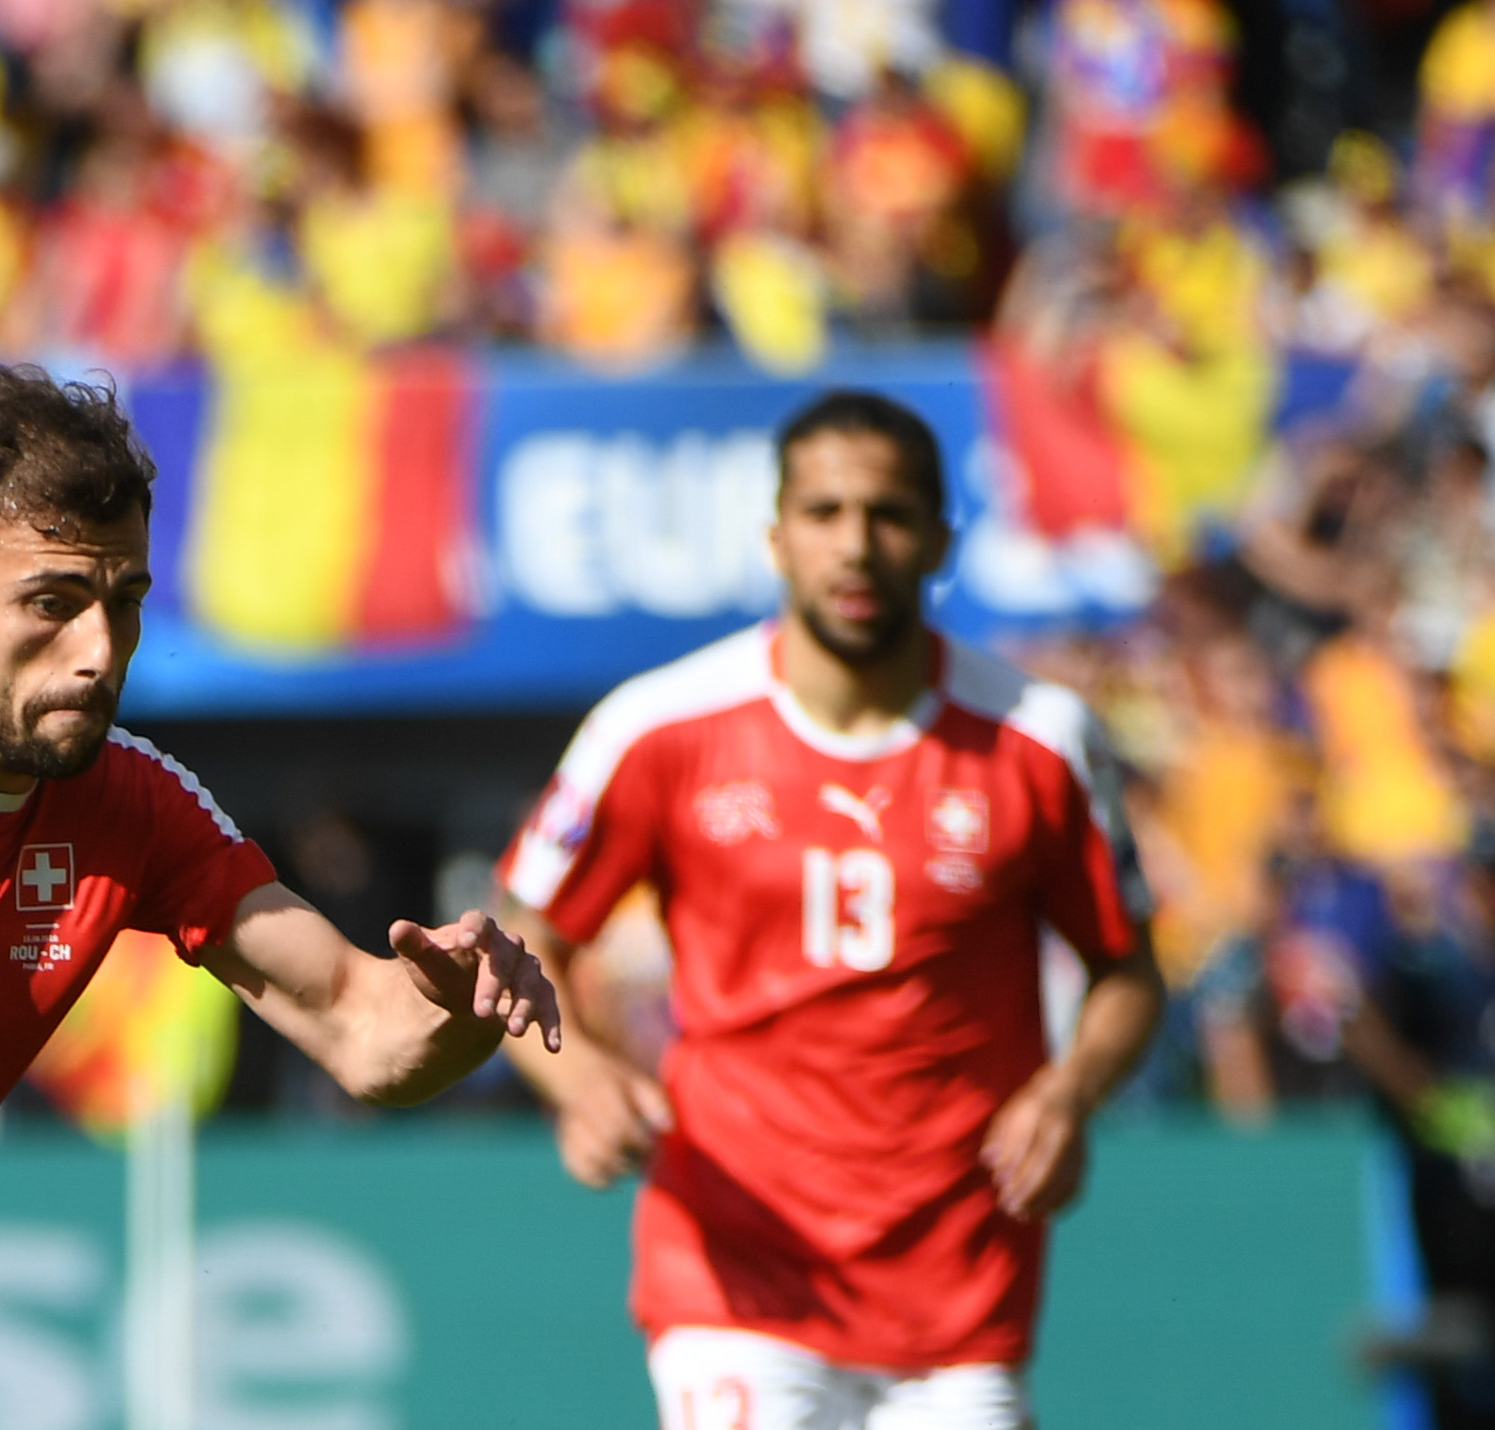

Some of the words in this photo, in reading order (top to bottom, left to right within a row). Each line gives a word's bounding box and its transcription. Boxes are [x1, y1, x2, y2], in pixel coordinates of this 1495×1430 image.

[802, 848, 895, 971] 13
[10, 945, 39, 960] ROU
[49, 944, 71, 960] CH
